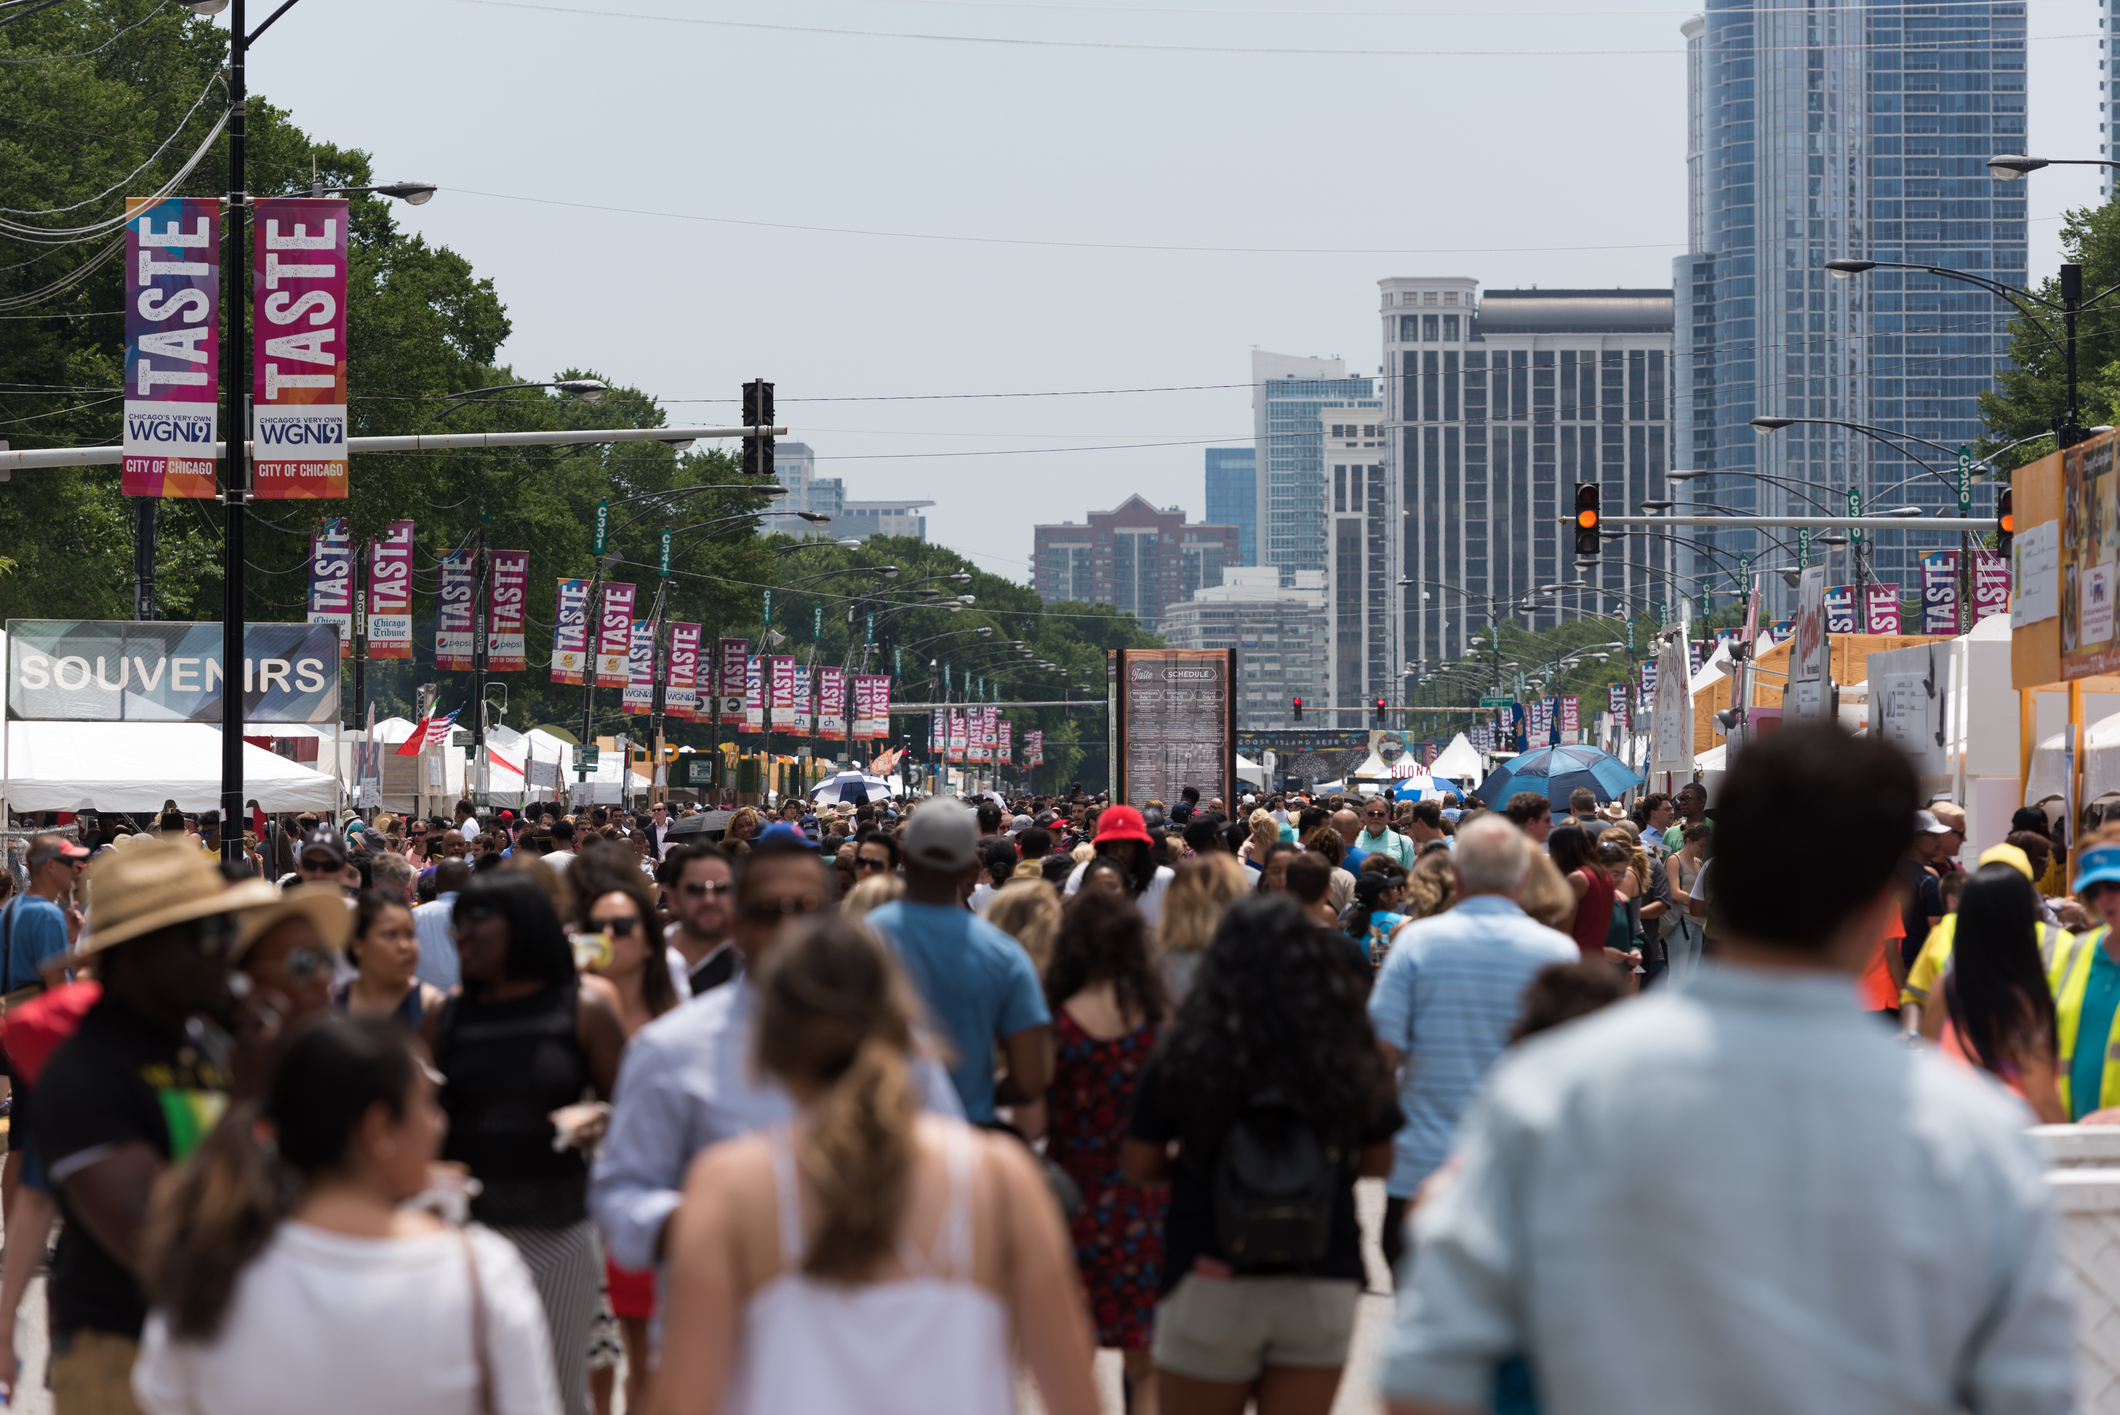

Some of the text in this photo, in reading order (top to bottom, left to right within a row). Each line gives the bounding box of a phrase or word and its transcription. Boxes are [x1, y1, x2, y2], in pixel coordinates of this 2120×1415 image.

[138, 216, 210, 395] TASTE
[265, 219, 336, 399] TASTE
[129, 421, 210, 443] WGN9
[260, 424, 343, 444] WGN9
[126, 460, 212, 475] CITY OF CHICAGO
[259, 464, 343, 476] CITY OF CHICAGO
[1959, 454, 1970, 504] C320
[596, 506, 607, 548] C331
[1850, 496, 1860, 537] C30
[662, 534, 671, 571] C341
[1800, 530, 1808, 568] C340
[441, 556, 472, 630] TASTE
[1740, 559, 1748, 593] C400
[1976, 558, 2007, 624] ASTE
[494, 558, 524, 632] TASTE
[1828, 592, 1853, 632] STE
[1925, 558, 1954, 632] TASTE
[374, 618, 405, 628] Chicago
[374, 628, 405, 637] Tribune
[558, 585, 587, 649] TASTE
[602, 589, 631, 653] TASTE
[449, 639, 472, 648] pepsi
[501, 640, 522, 650] pepsi
[670, 628, 697, 685] TASTE
[724, 644, 745, 696] TASTE
[773, 660, 792, 707] TASTE
[1132, 668, 1153, 680] Taste
[625, 689, 652, 698] WGN9
[667, 692, 694, 701] WGN9
[822, 671, 839, 714] TASTE
[856, 680, 871, 717] TASTE
[873, 679, 888, 717] TASTE
[795, 715, 804, 725] ch
[824, 717, 834, 726] ch
[1542, 698, 1554, 731] TASTE
[1563, 698, 1576, 730] TASTE
[970, 719, 982, 748] TASTE
[999, 722, 1010, 748] TASTE
[1391, 765, 1431, 778] BUONA
